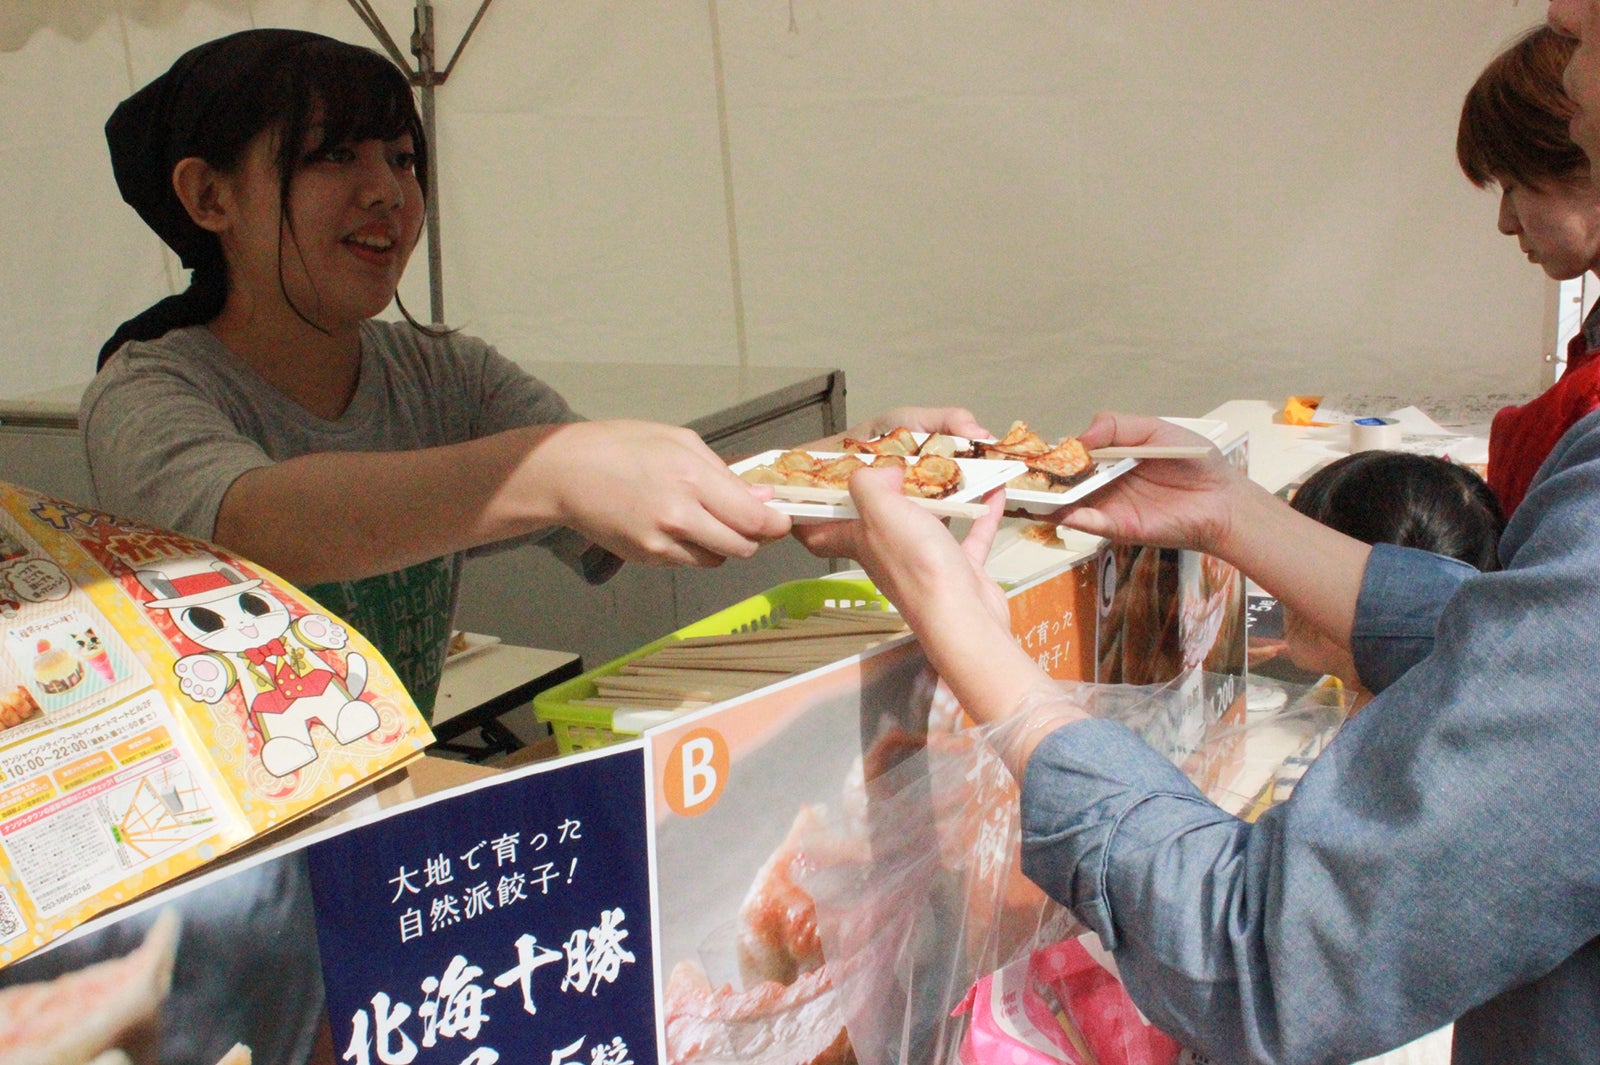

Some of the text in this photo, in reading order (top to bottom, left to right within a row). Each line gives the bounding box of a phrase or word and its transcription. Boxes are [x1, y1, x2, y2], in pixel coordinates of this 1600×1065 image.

[1031, 640, 1071, 673] 餃子!
[681, 736, 718, 809] B
[388, 818, 582, 904] 大地で育った
[399, 857, 578, 943] 自然派餃子!
[342, 907, 636, 1065] 北海十勝
